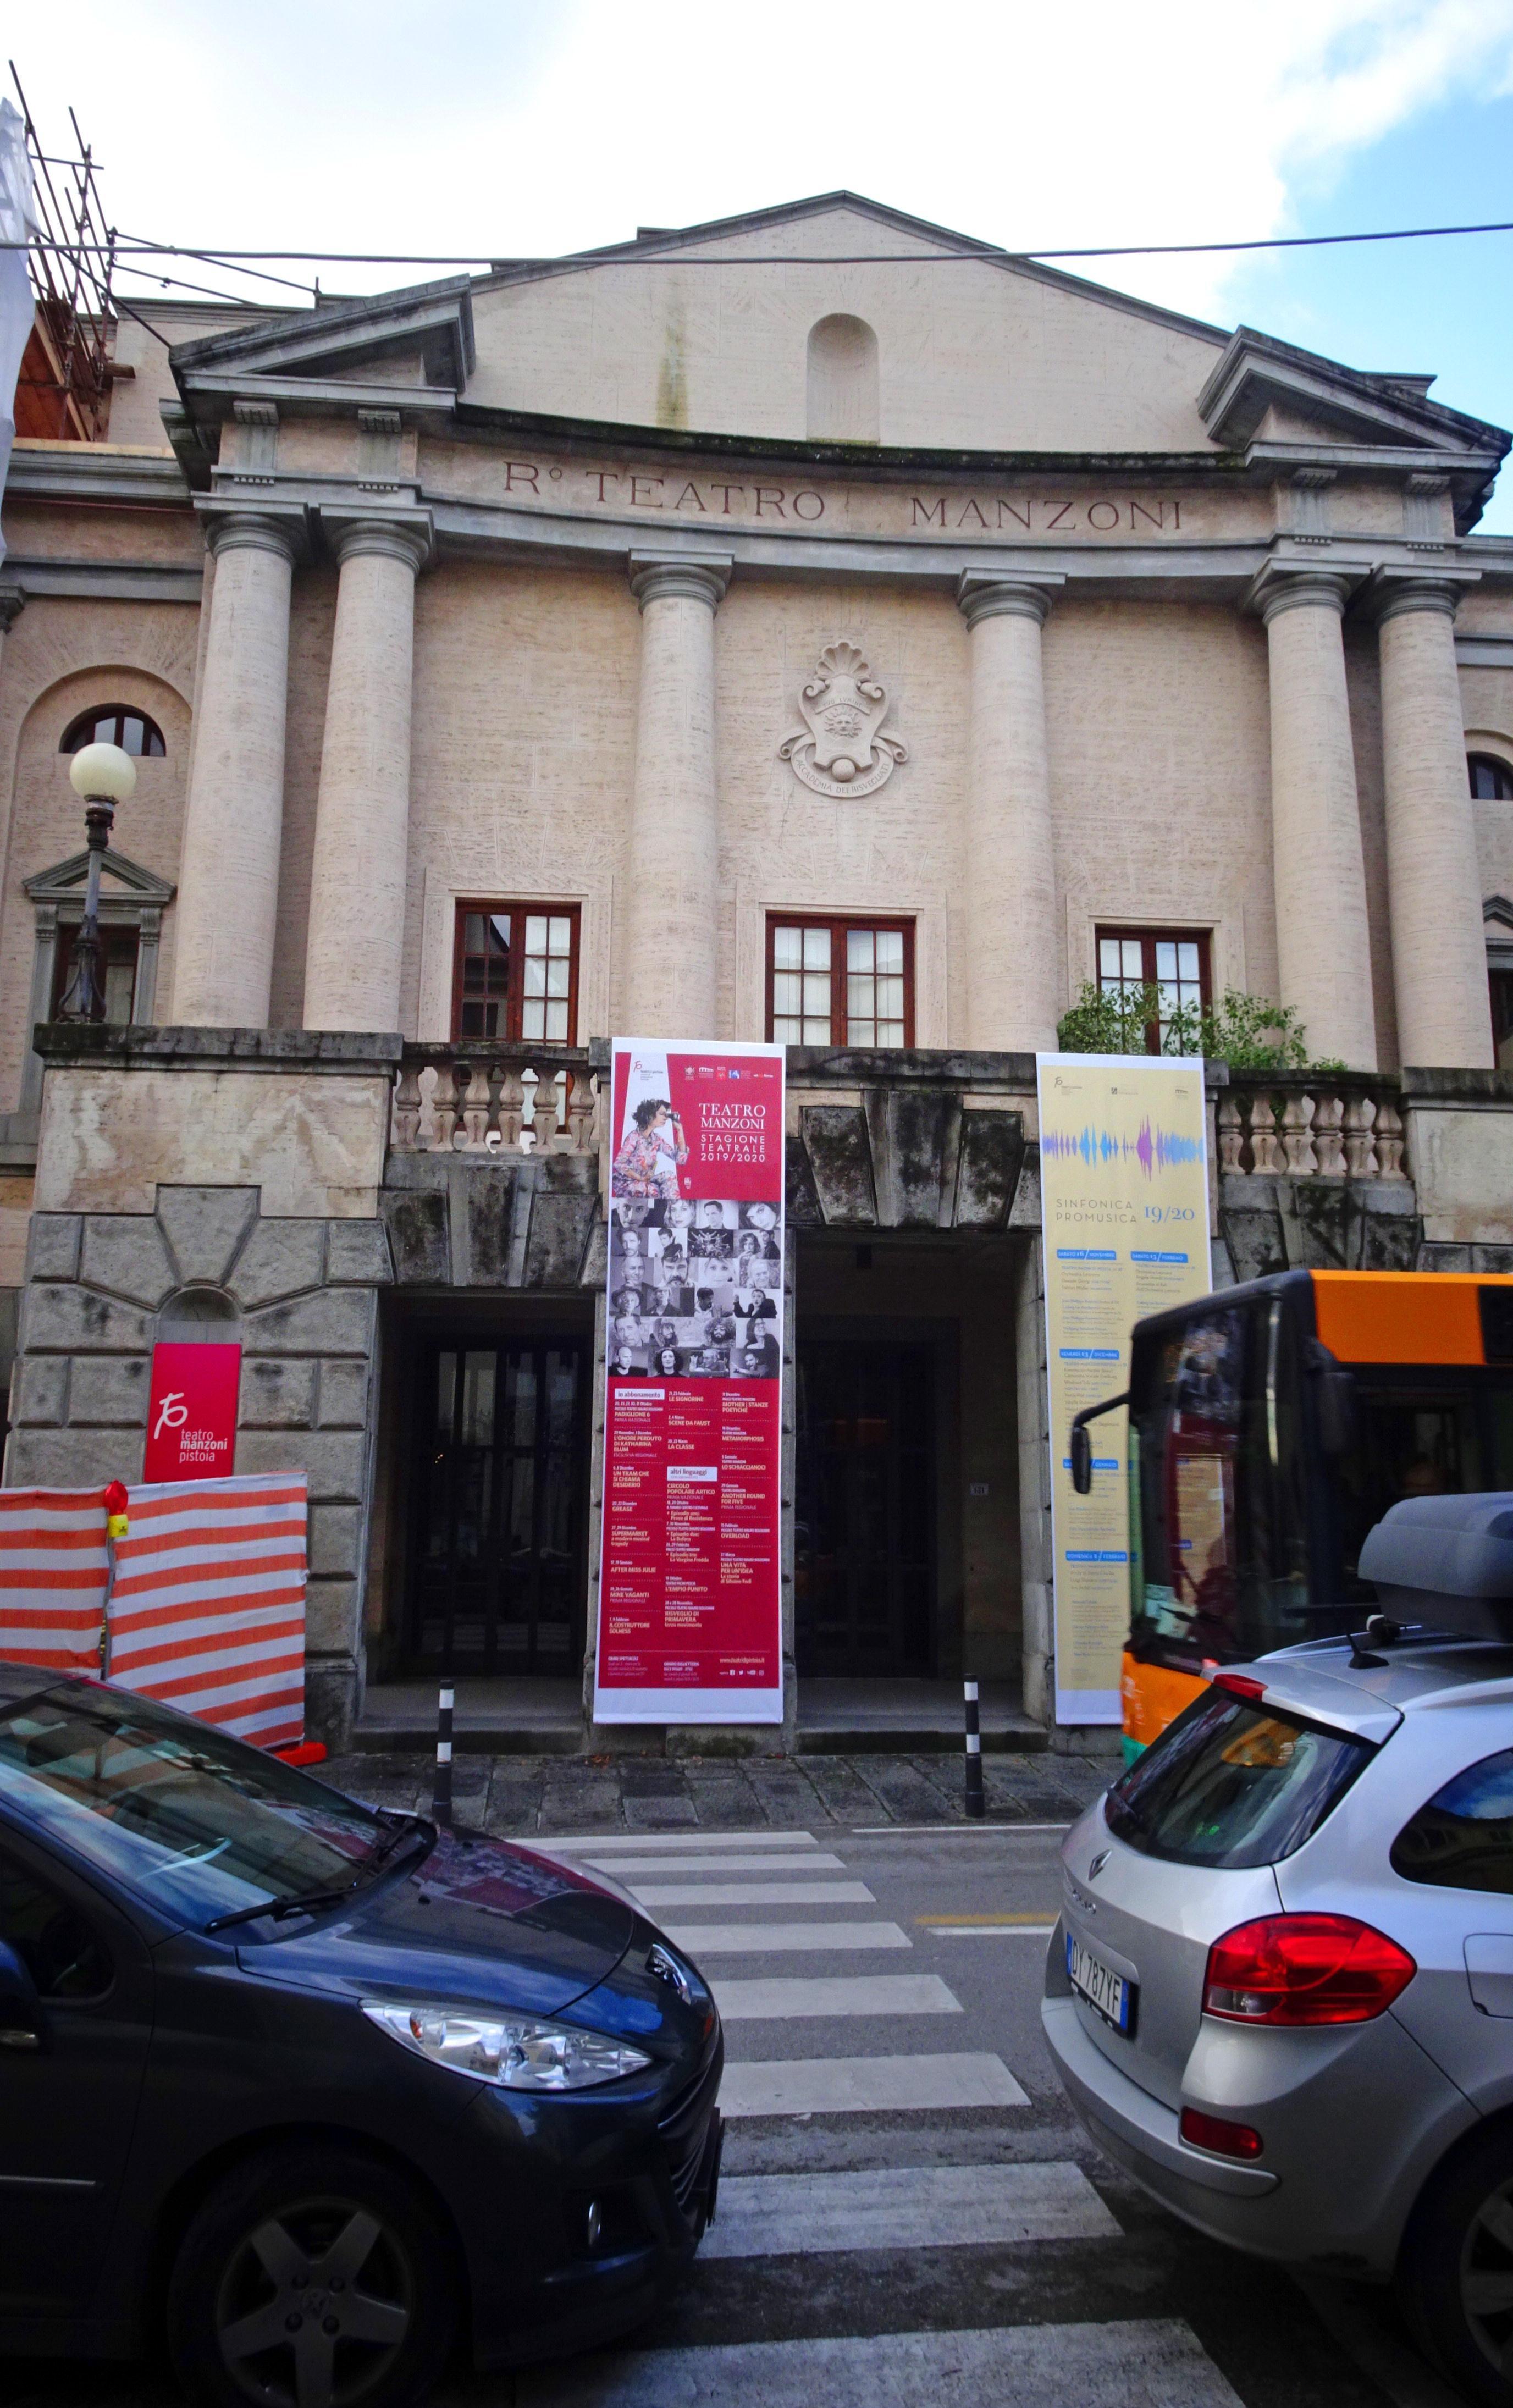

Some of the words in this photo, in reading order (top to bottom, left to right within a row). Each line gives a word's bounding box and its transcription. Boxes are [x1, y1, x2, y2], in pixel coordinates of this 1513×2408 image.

[586, 472, 826, 521] TEATRO
[909, 496, 1183, 531] MANZONI
[796, 760, 831, 791] ACCADEMIA
[699, 1103, 766, 1117] TEATRO
[700, 1117, 764, 1129] MANZONI
[700, 1134, 765, 1144] STAGIONE
[700, 1144, 765, 1153] TEATRALE
[700, 1153, 765, 1162] 2019/2020
[1056, 1199, 1133, 1209] SINFONICA
[1056, 1212, 1137, 1223] PROMUSICA
[1144, 1205, 1195, 1224] 19/20
[181, 1429, 213, 1441] teatro
[180, 1438, 228, 1452] manzoni
[179, 1450, 215, 1463] pistoia
[1072, 1941, 1084, 1981] DY
[1087, 1955, 1120, 2014] 787YF
